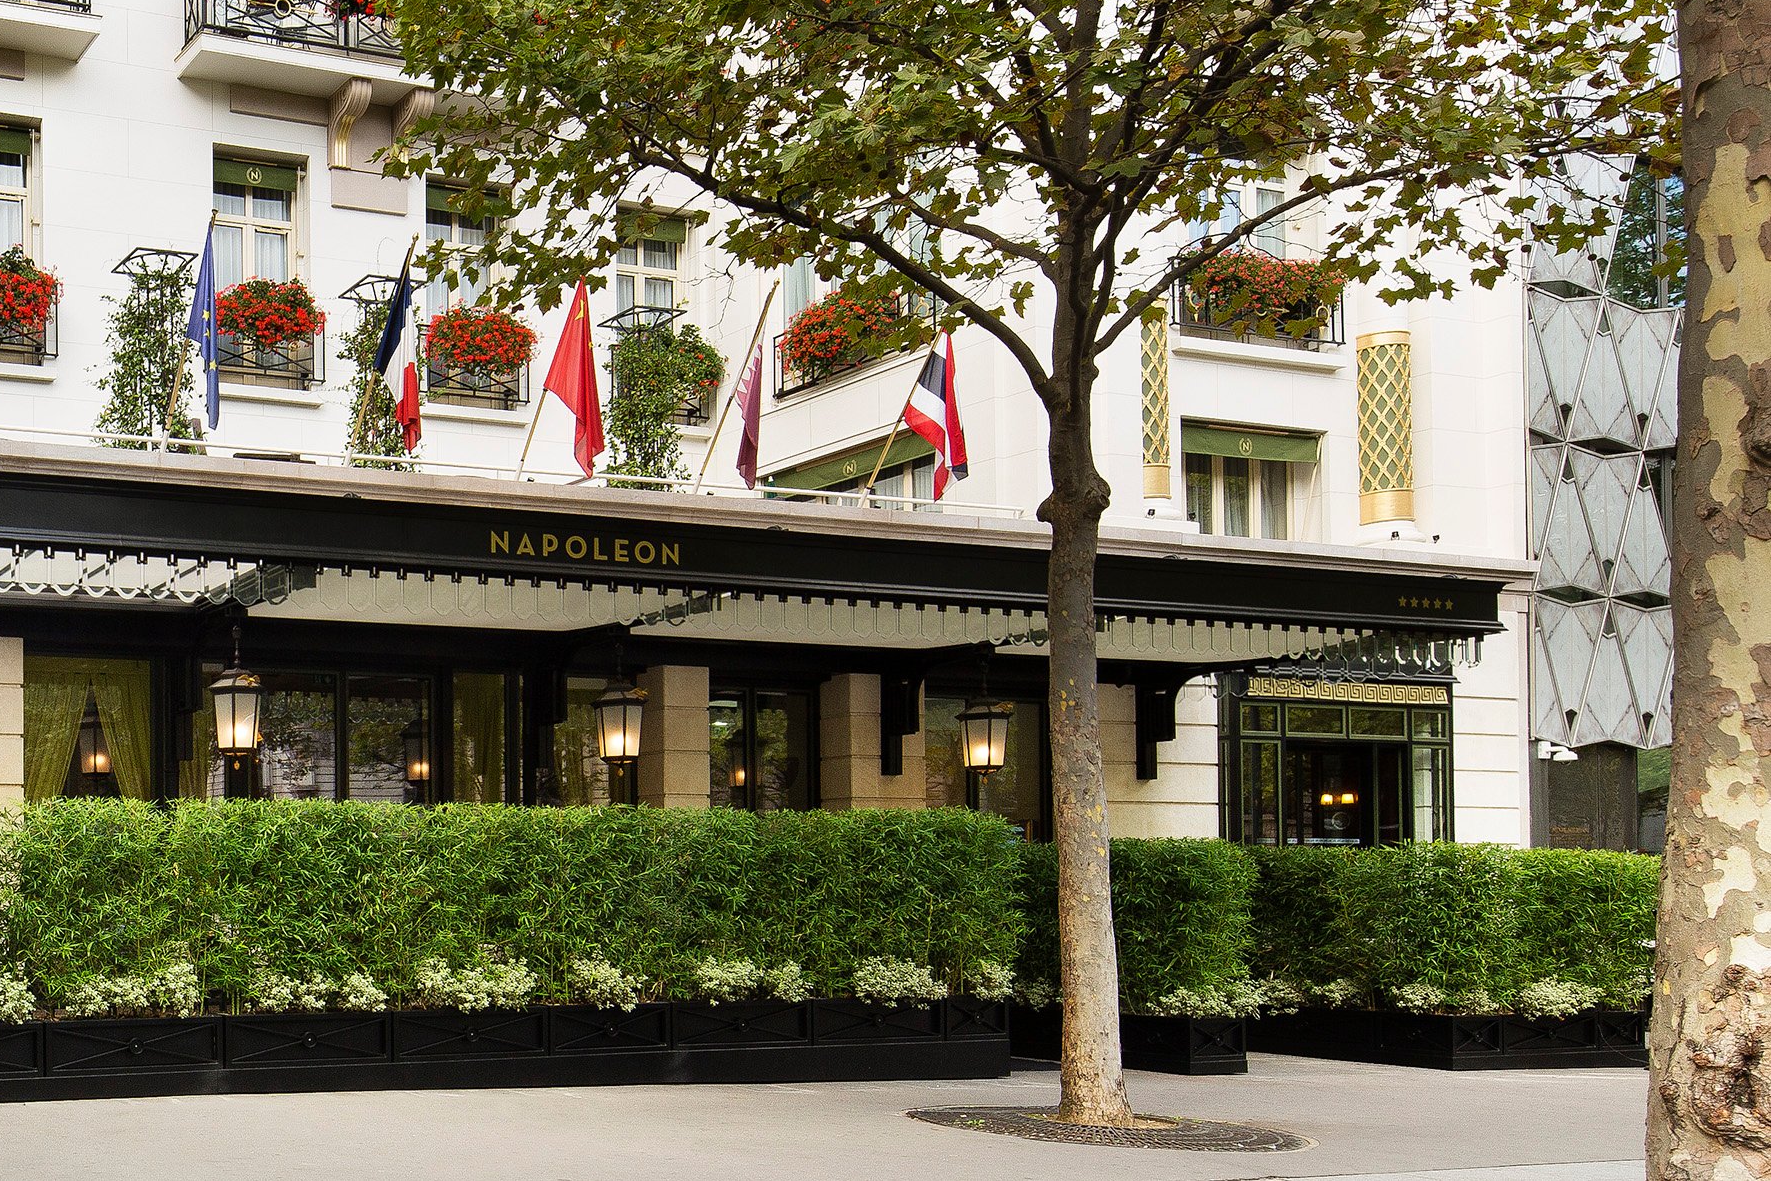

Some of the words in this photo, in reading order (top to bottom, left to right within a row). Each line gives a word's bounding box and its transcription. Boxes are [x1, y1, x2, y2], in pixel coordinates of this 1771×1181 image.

[250, 170, 258, 180] N
[1242, 442, 1249, 451] N
[846, 463, 853, 474] N
[490, 530, 680, 566] NAPOLEON
